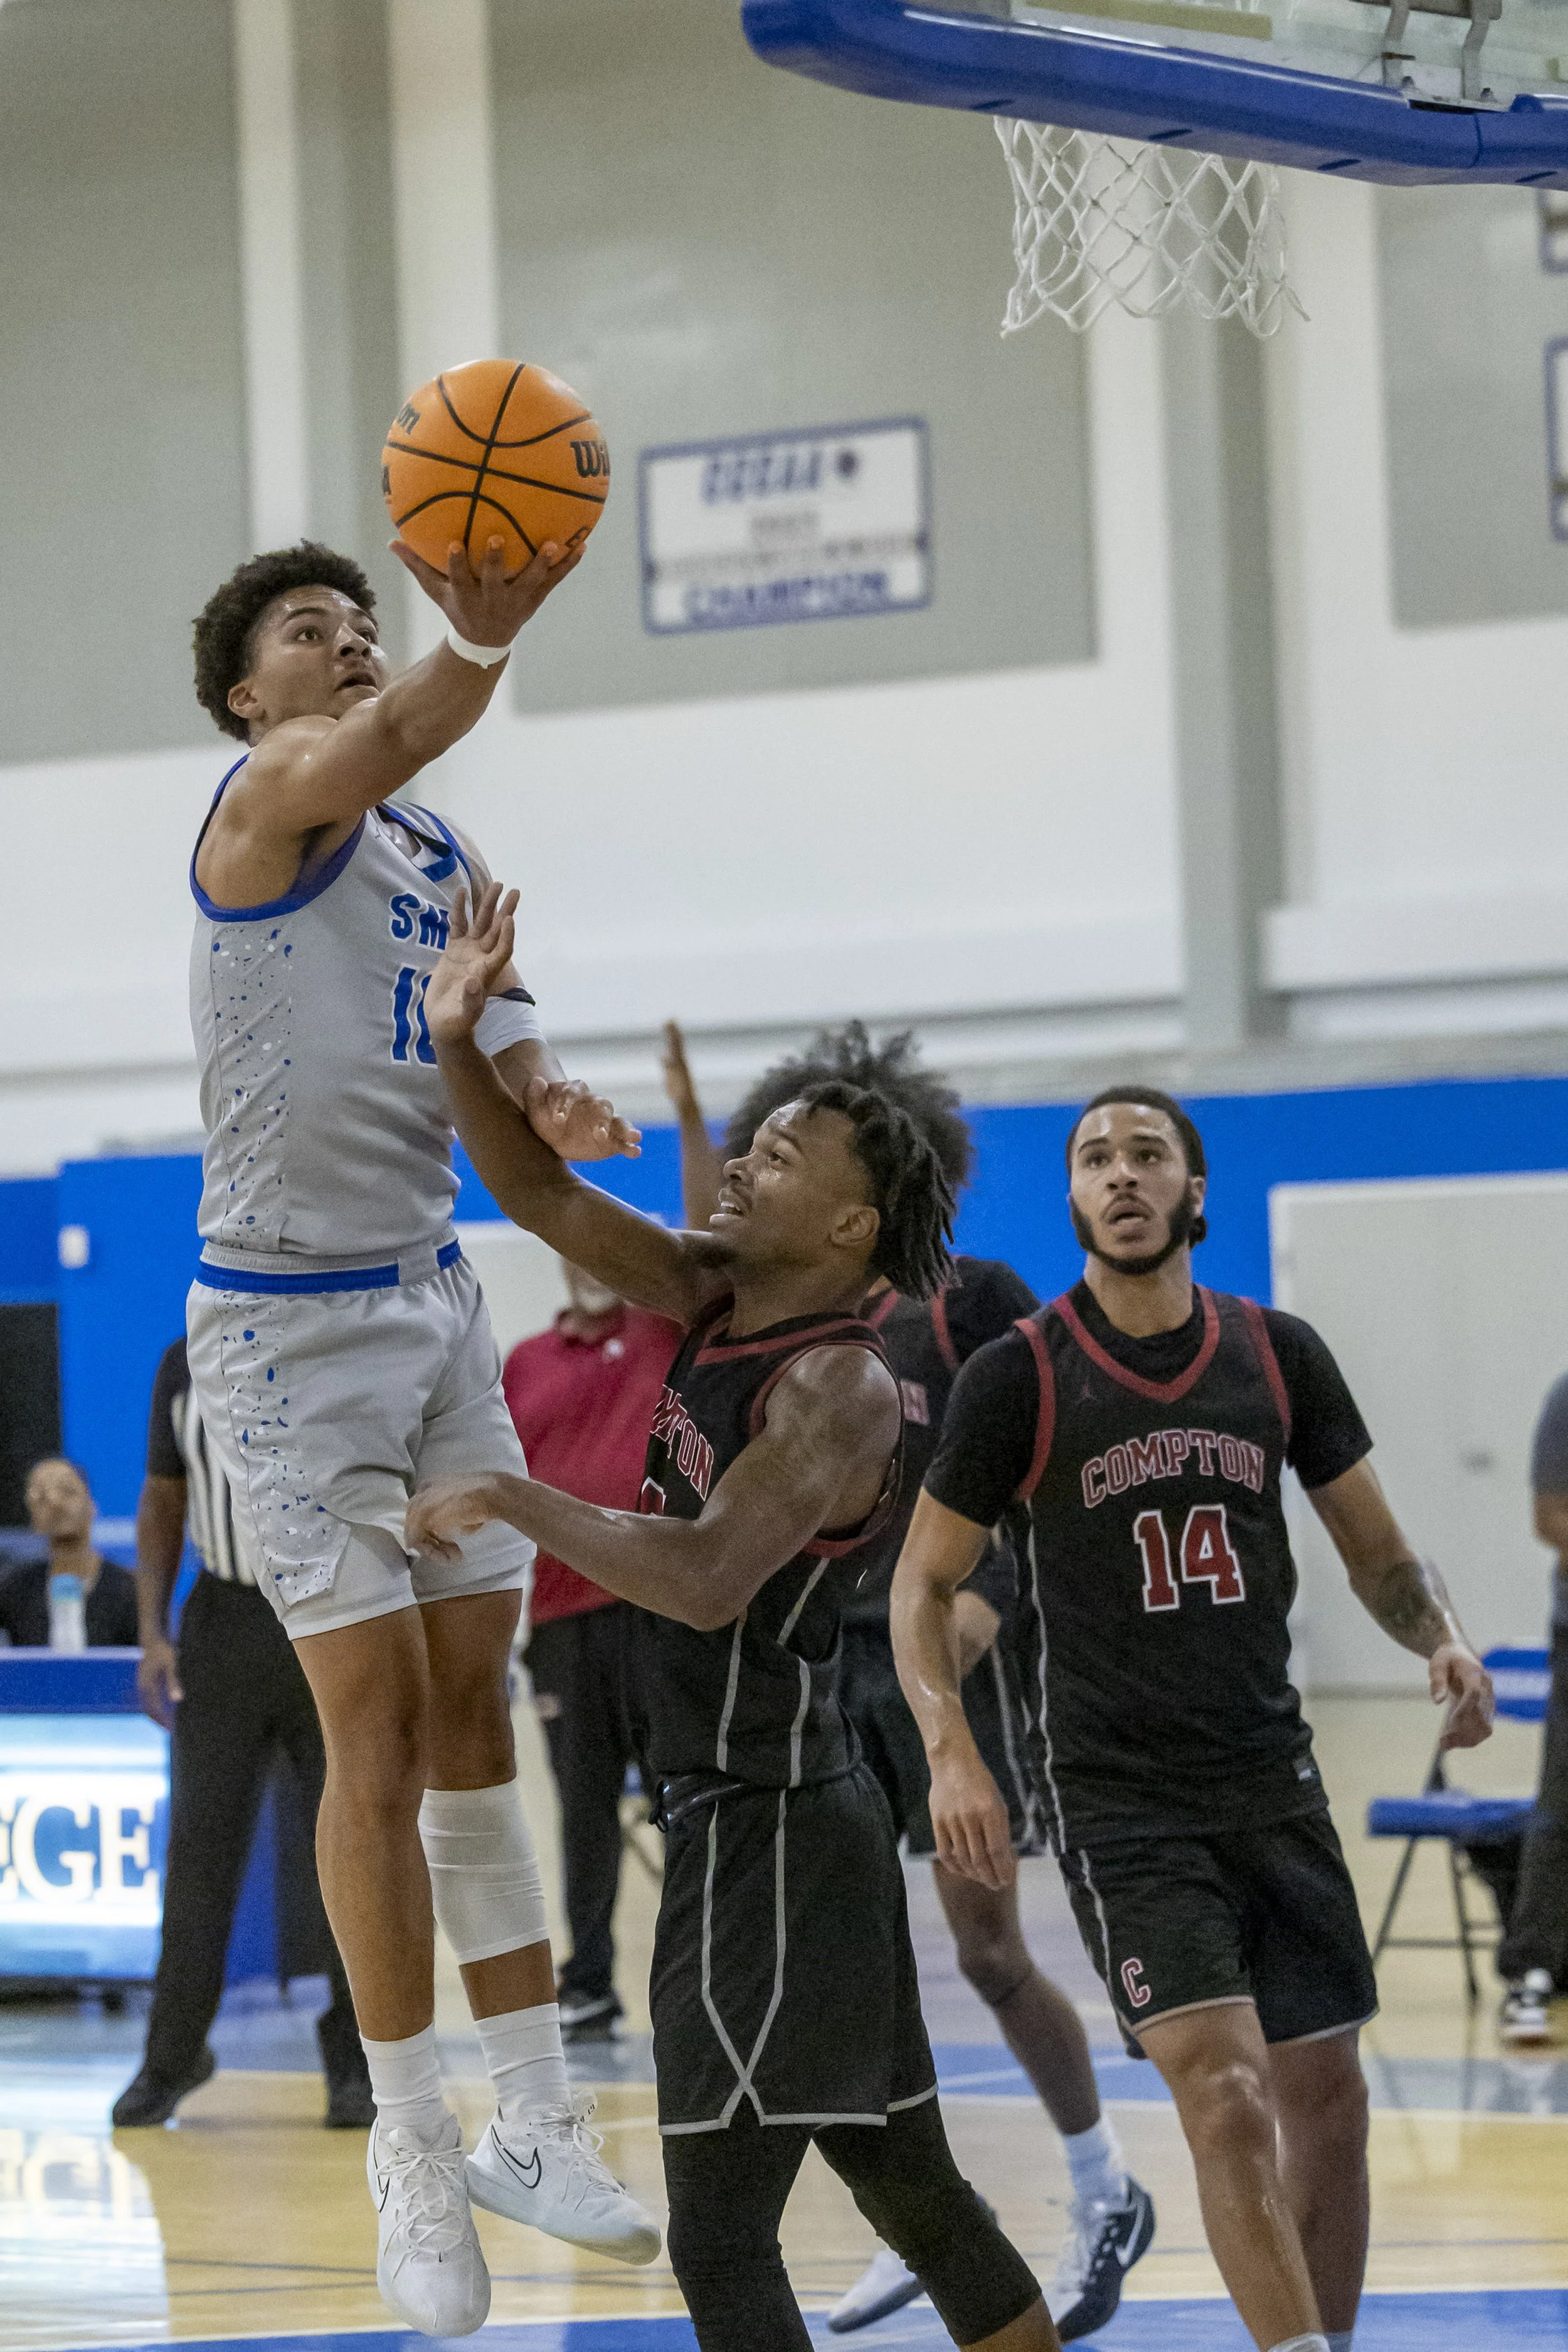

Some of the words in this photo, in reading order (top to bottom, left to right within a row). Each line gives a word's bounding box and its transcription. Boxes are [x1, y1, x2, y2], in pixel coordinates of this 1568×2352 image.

[1081, 1428, 1265, 1509] COMPTON
[1133, 1504, 1246, 1613] 14
[1121, 1957, 1152, 2008] C
